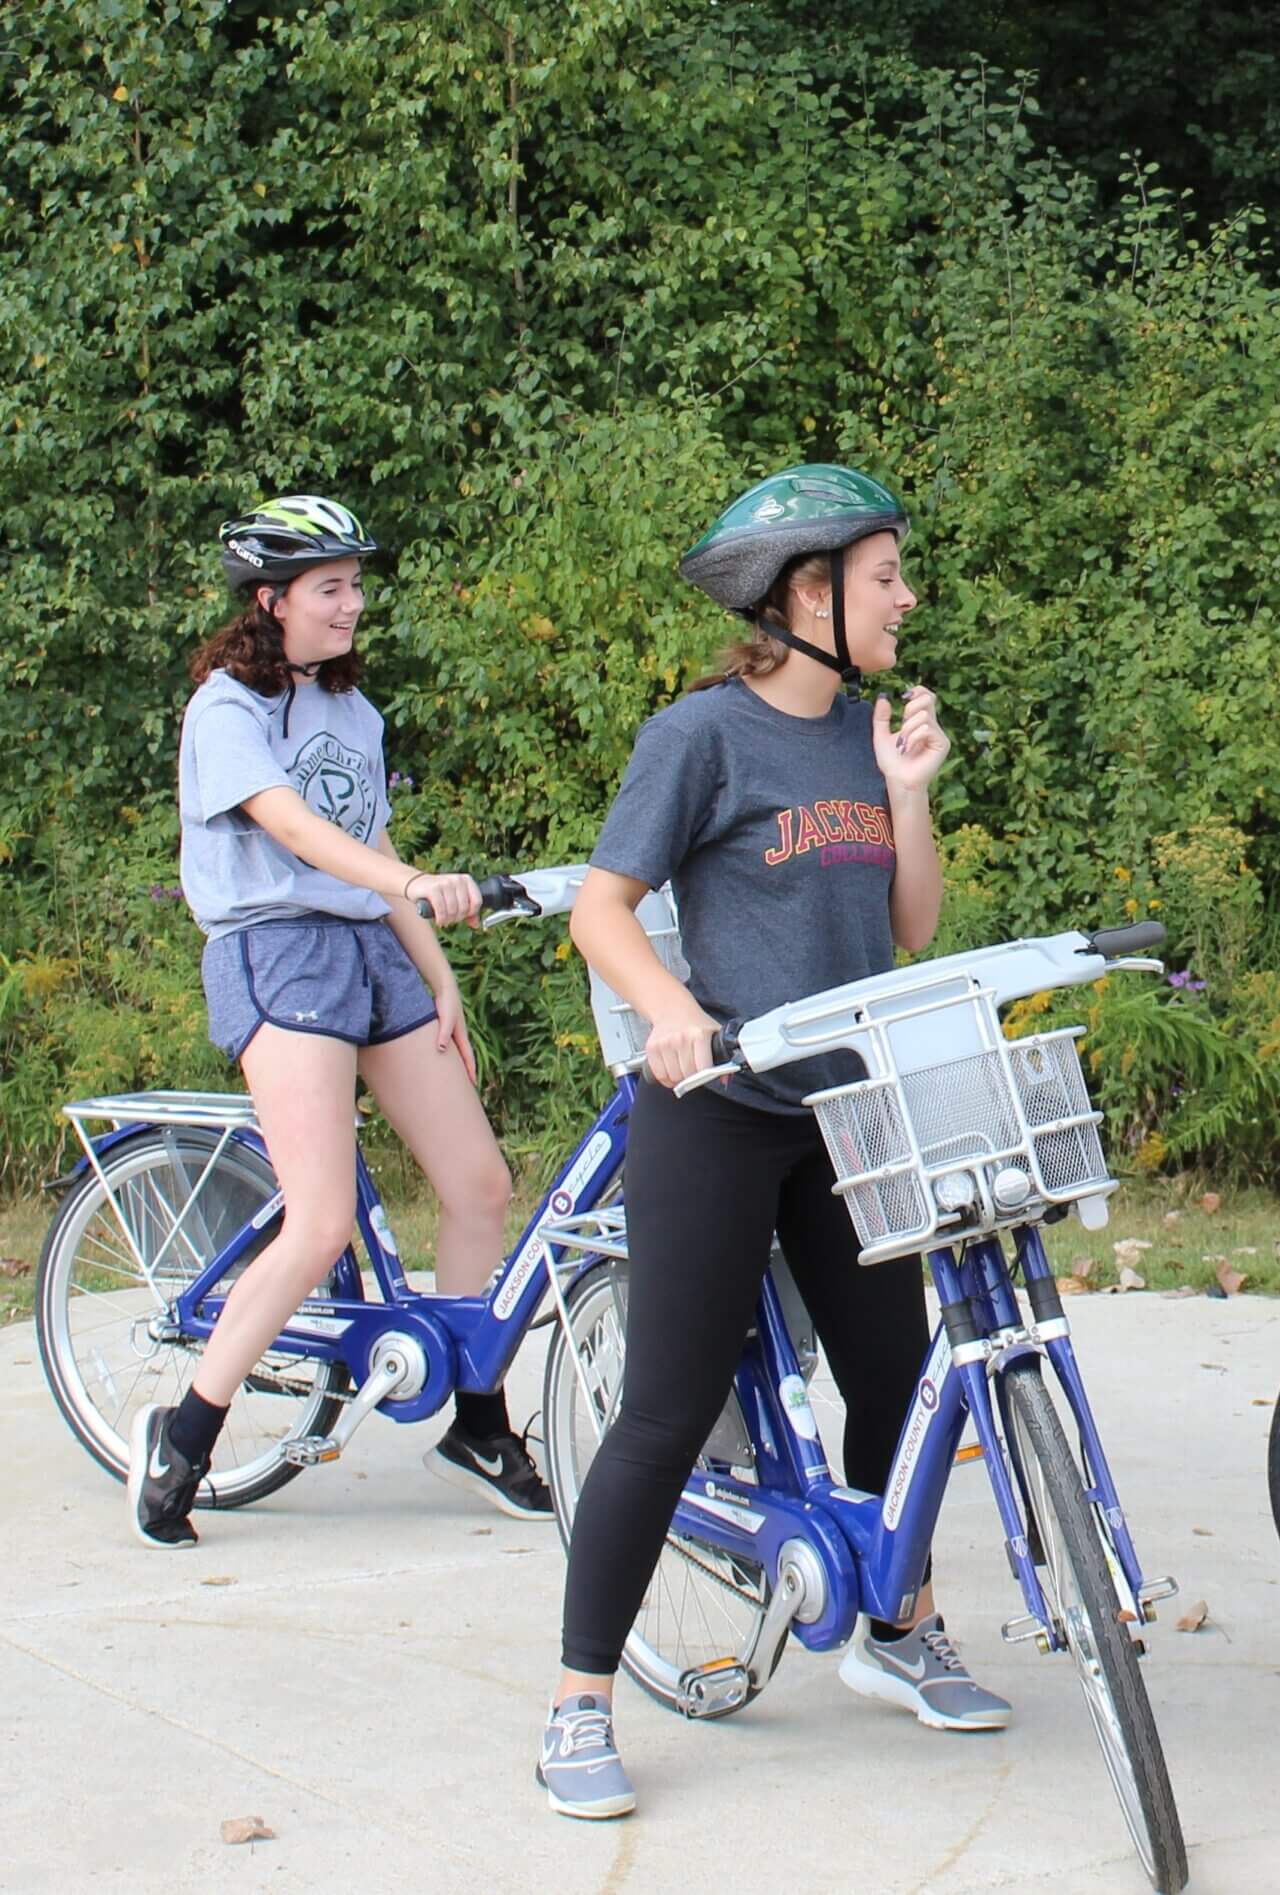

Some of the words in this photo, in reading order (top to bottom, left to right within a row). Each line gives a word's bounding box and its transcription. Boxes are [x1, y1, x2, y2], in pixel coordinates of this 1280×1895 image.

[765, 800, 896, 866] JACKSO
[498, 1261, 531, 1314] JACKSON
[887, 1462, 910, 1524] JACKSON
[904, 1410, 927, 1461] COUNTY
